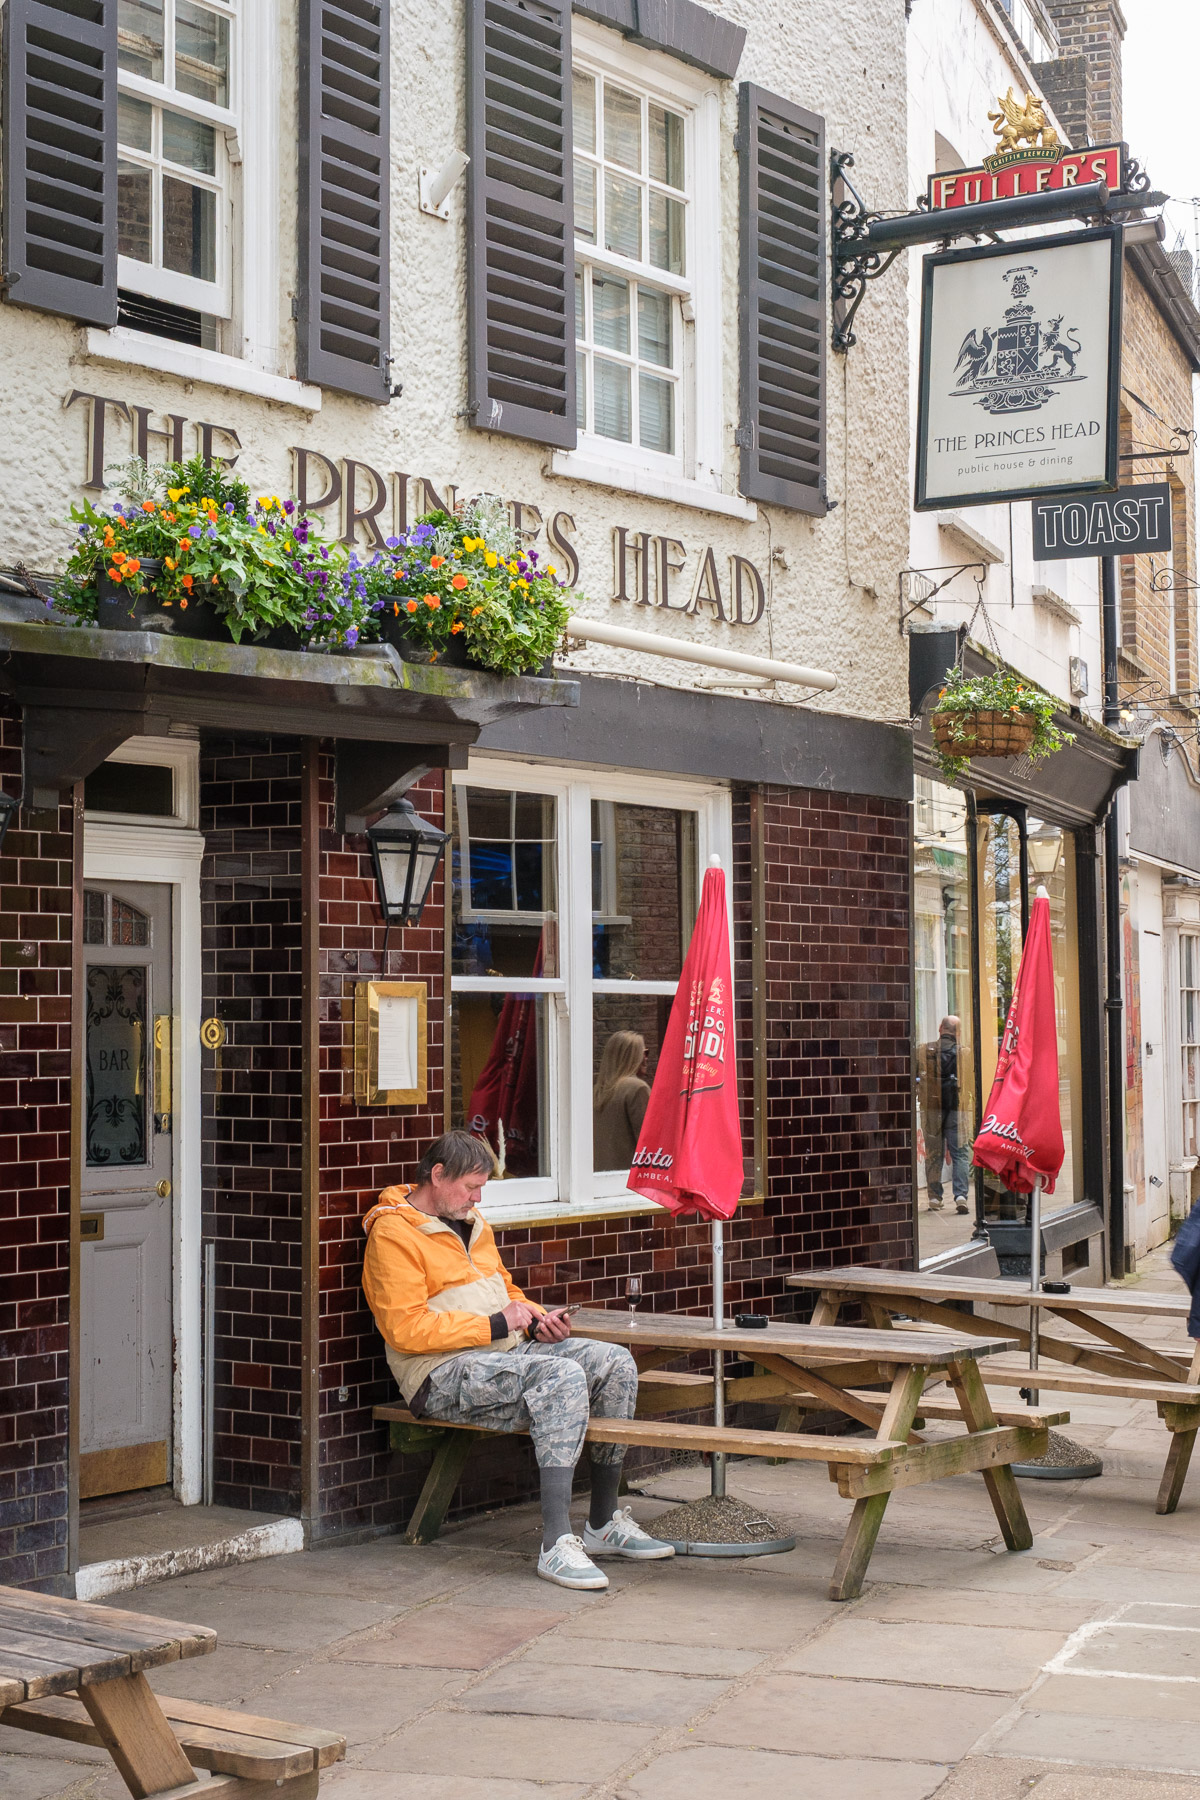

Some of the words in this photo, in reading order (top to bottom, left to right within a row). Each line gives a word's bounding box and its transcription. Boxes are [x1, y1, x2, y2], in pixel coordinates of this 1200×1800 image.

[993, 153, 1021, 167] GRIFFIN
[1023, 149, 1055, 159] BREWERY
[939, 156, 1108, 209] FULLER'S
[934, 435, 967, 453] THE
[974, 426, 1045, 449] PRINCES
[1051, 420, 1101, 440] HEAD
[957, 463, 990, 476] public
[993, 460, 1024, 471] house
[1028, 458, 1036, 467] &
[1040, 455, 1074, 466] dining
[1037, 497, 1163, 548] TOAST
[612, 526, 765, 626] HEAD
[99, 1048, 131, 1072] BAR
